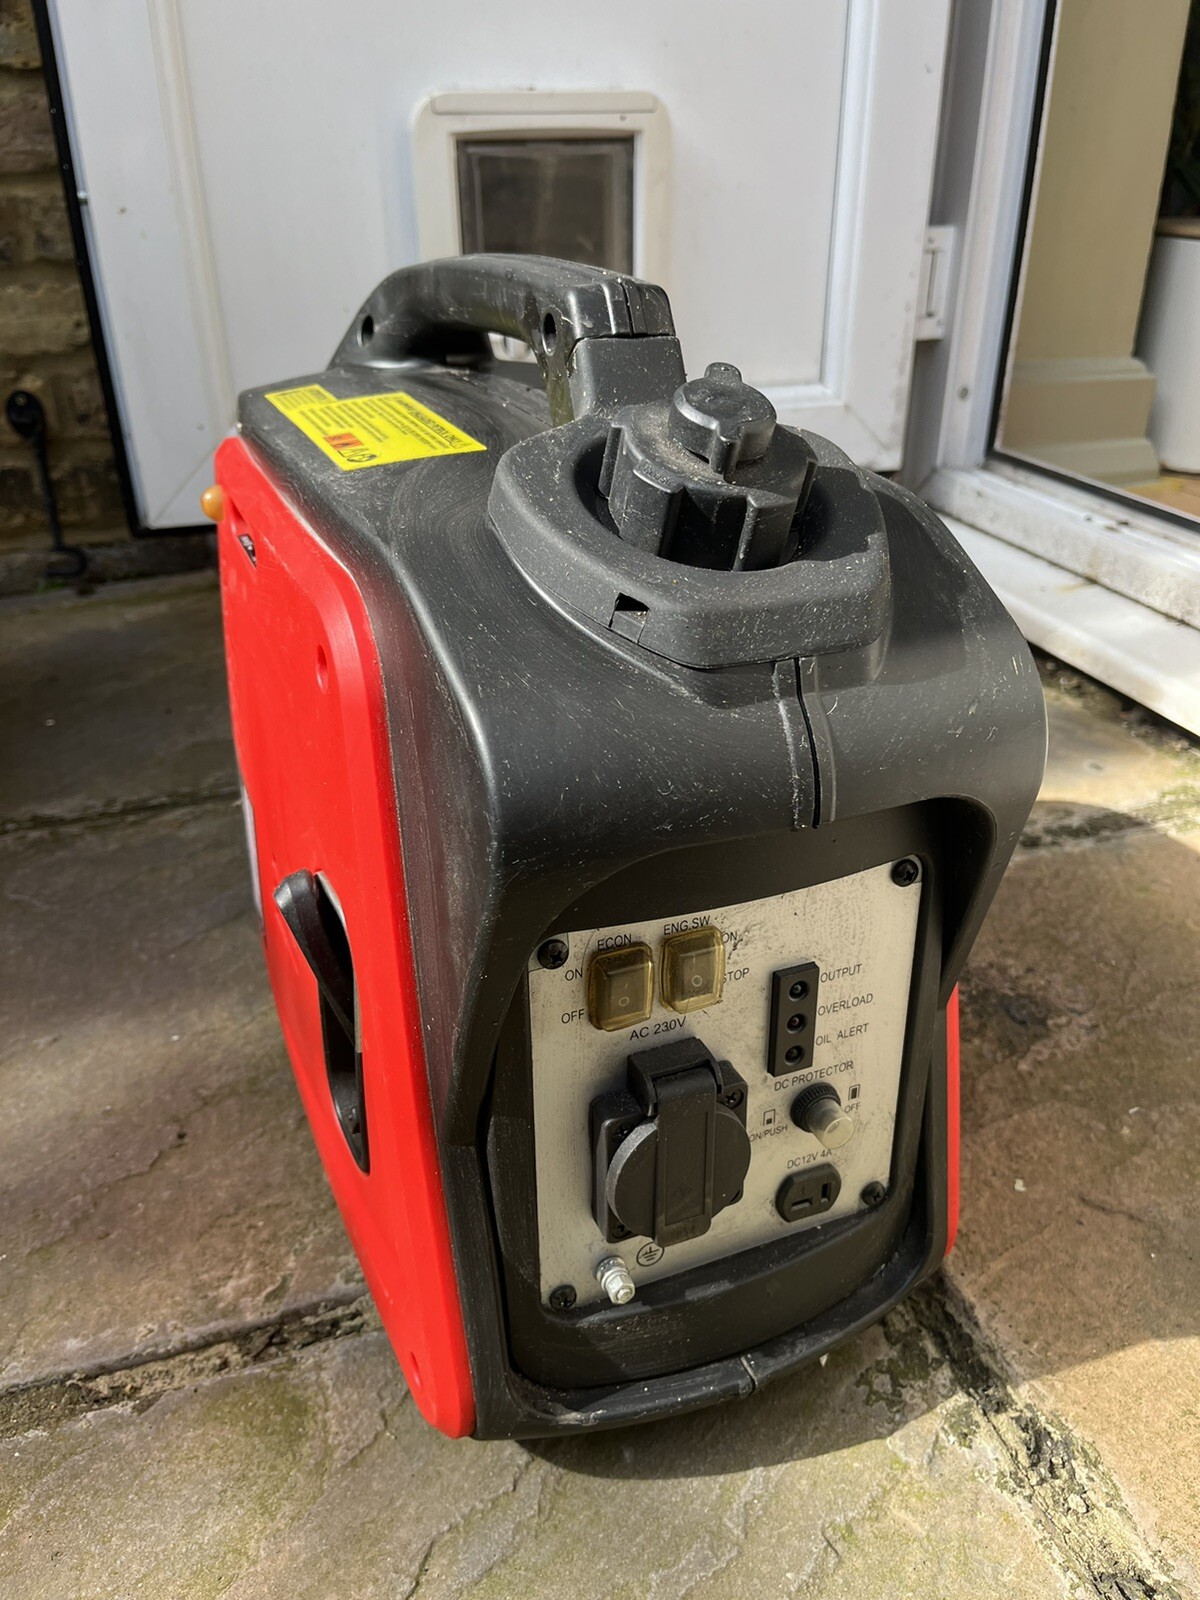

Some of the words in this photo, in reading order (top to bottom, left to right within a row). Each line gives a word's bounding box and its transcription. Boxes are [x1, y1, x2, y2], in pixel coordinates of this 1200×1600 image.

[664, 915, 711, 936] ENG.SW
[597, 934, 632, 950] ECON
[564, 968, 583, 982] ON
[820, 963, 863, 983] OUTPUT
[817, 993, 874, 1016] OVERLOAD
[560, 1009, 585, 1025] OFF
[629, 1027, 650, 1041] AC
[653, 1016, 687, 1035] 230V
[815, 1034, 831, 1046] OIL
[836, 1022, 870, 1040] ALERT
[774, 1079, 790, 1092] DC
[791, 1060, 854, 1086] PROTECTOR
[844, 1101, 861, 1114] OFF
[786, 1152, 818, 1170] DC12V
[820, 1148, 833, 1159] 4A
